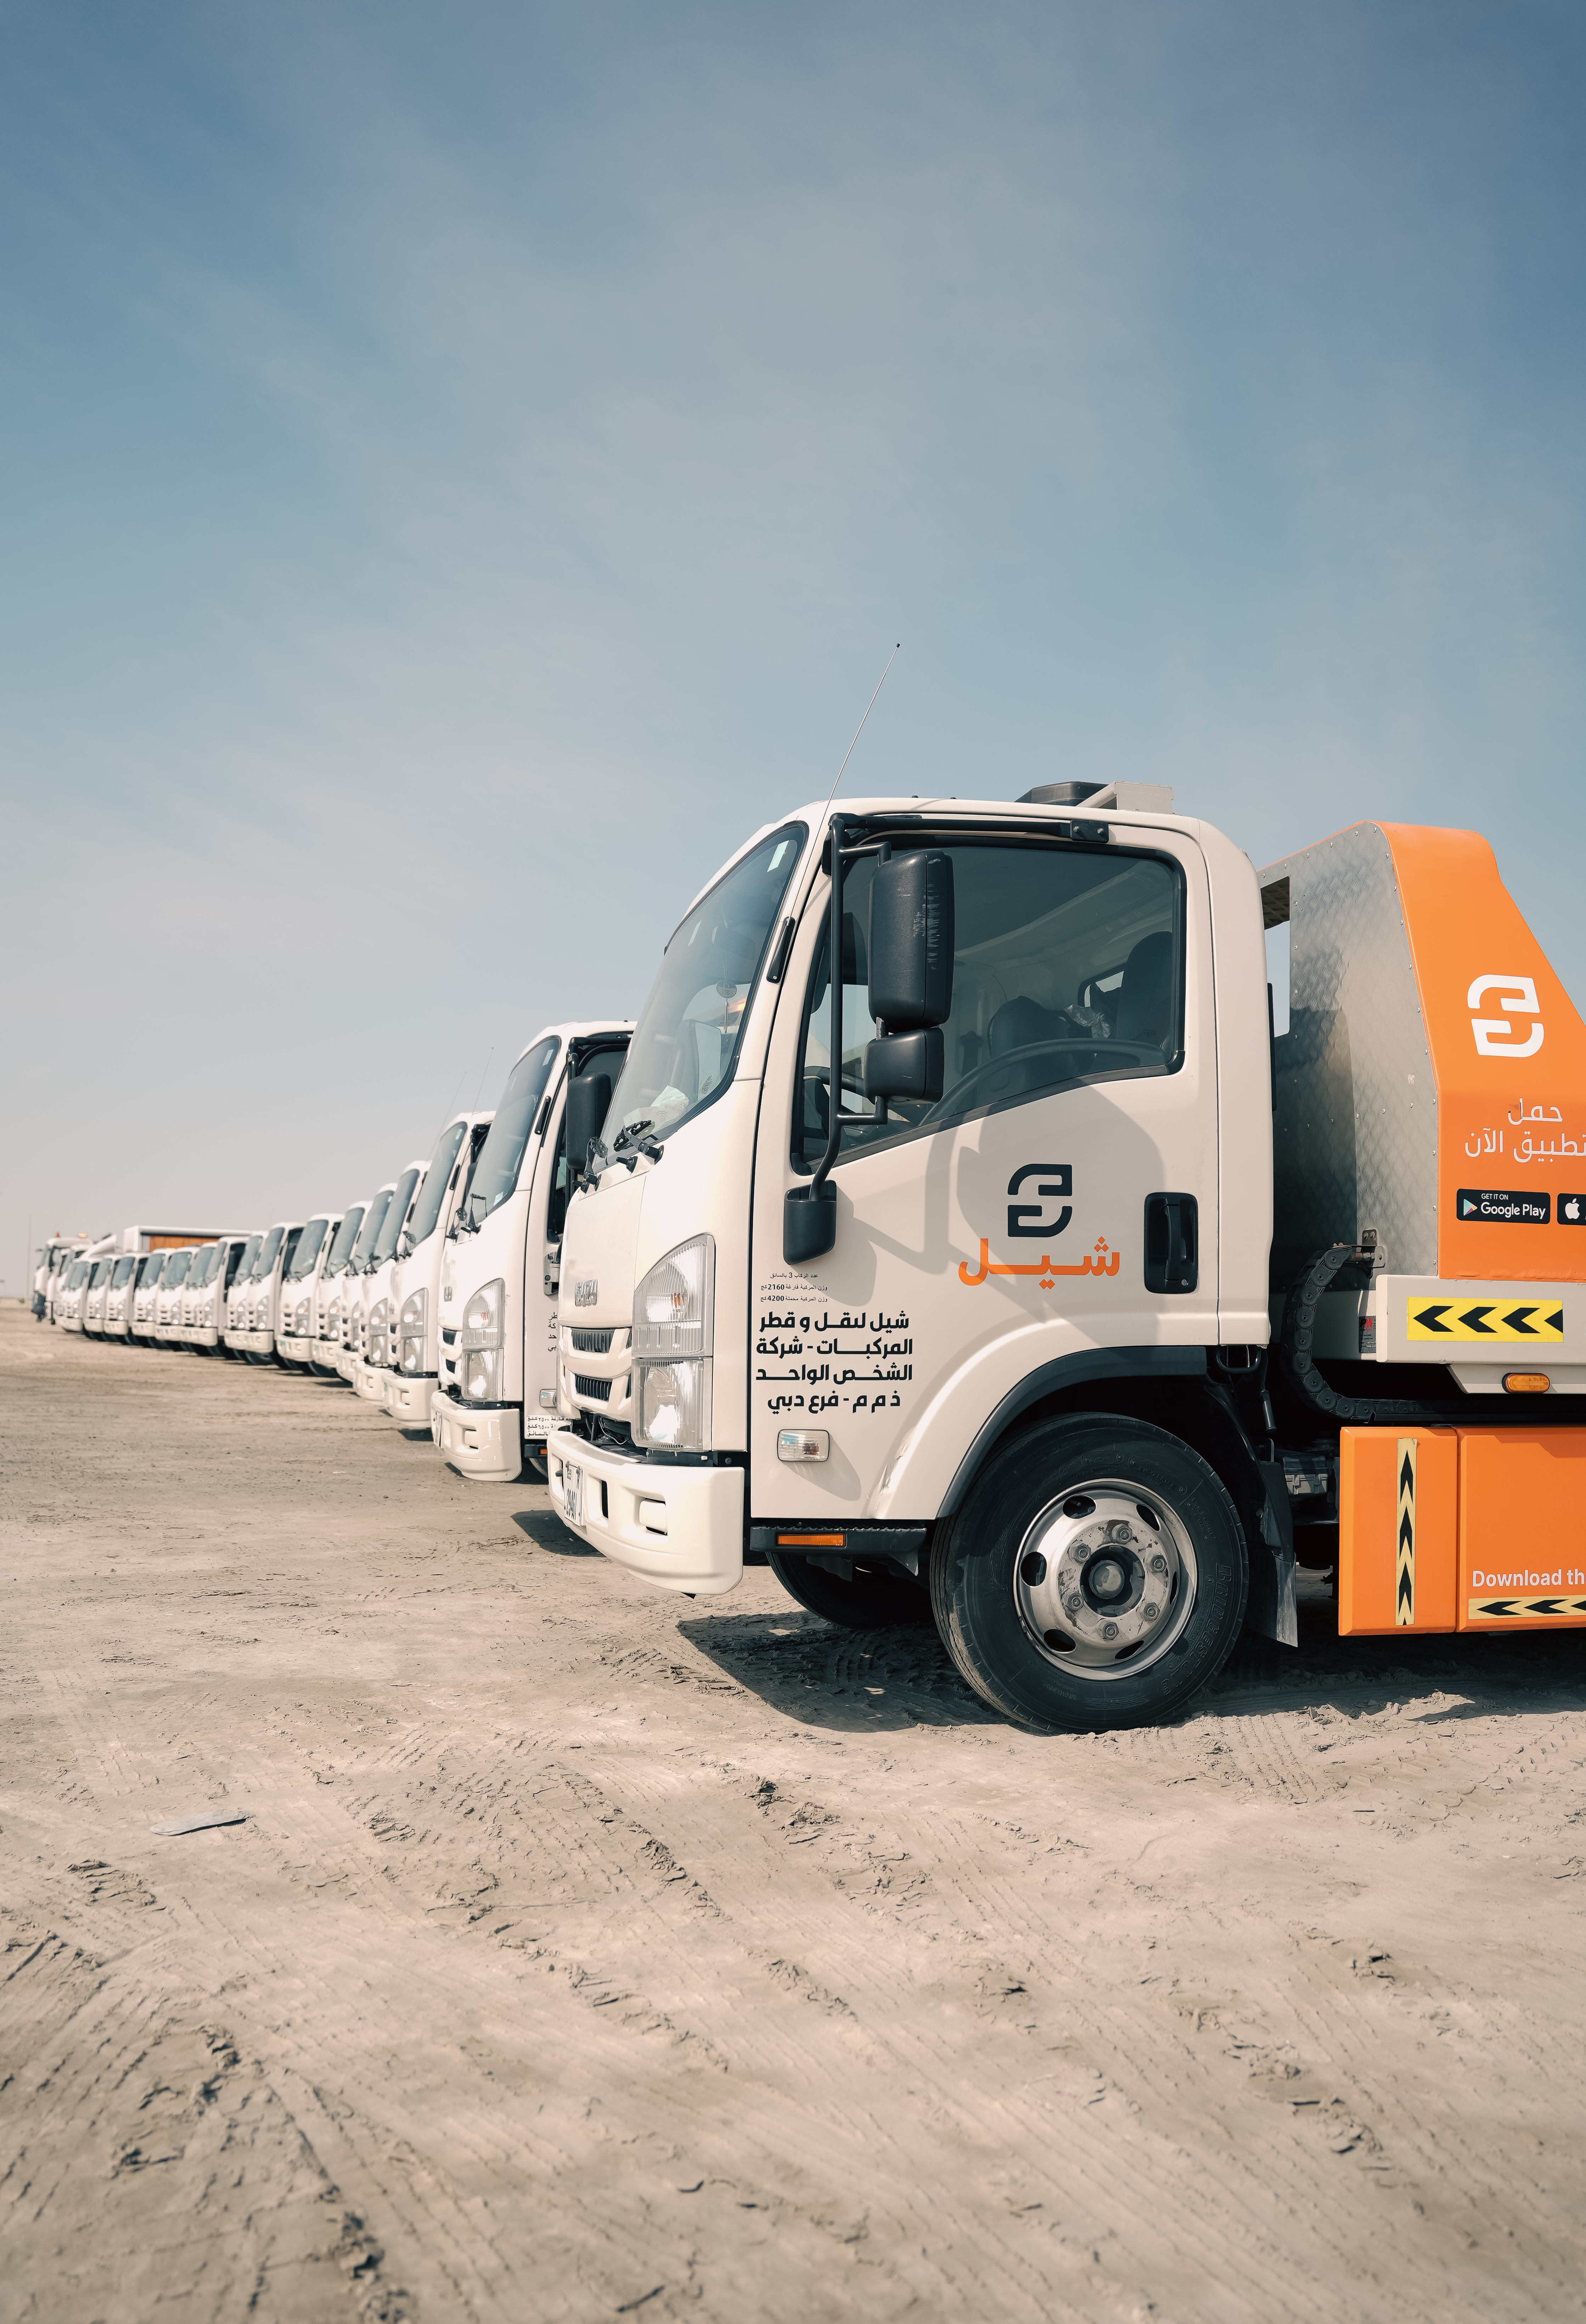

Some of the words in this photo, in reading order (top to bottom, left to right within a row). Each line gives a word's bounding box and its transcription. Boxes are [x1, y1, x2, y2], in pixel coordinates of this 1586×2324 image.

[1508, 1098, 1563, 1125] حمل
[1466, 1128, 1503, 1157] الآن
[1514, 1131, 1586, 1162] تطبيق
[1481, 1202, 1520, 1218] Google
[1523, 1204, 1546, 1219] Play
[958, 1237, 1120, 1289] شيل
[548, 1312, 557, 1320] طر
[759, 1311, 795, 1332] قطر
[800, 1317, 810, 1333] و
[870, 1310, 909, 1334] شيل
[757, 1336, 803, 1359] شركة
[817, 1337, 912, 1359] المركبات
[756, 1364, 829, 1385] الواحد
[833, 1362, 912, 1385] الشخص
[768, 1396, 804, 1414] دبي
[809, 1390, 838, 1414] فرع
[853, 1395, 867, 1413] م
[871, 1395, 885, 1413] م
[890, 1390, 900, 1406] ذ
[1473, 1569, 1561, 1587] Download
[1567, 1569, 1586, 1585] th
[1161, 1562, 1232, 1696] BRIDGESTONE
[1042, 1680, 1076, 1700] RADIAL
